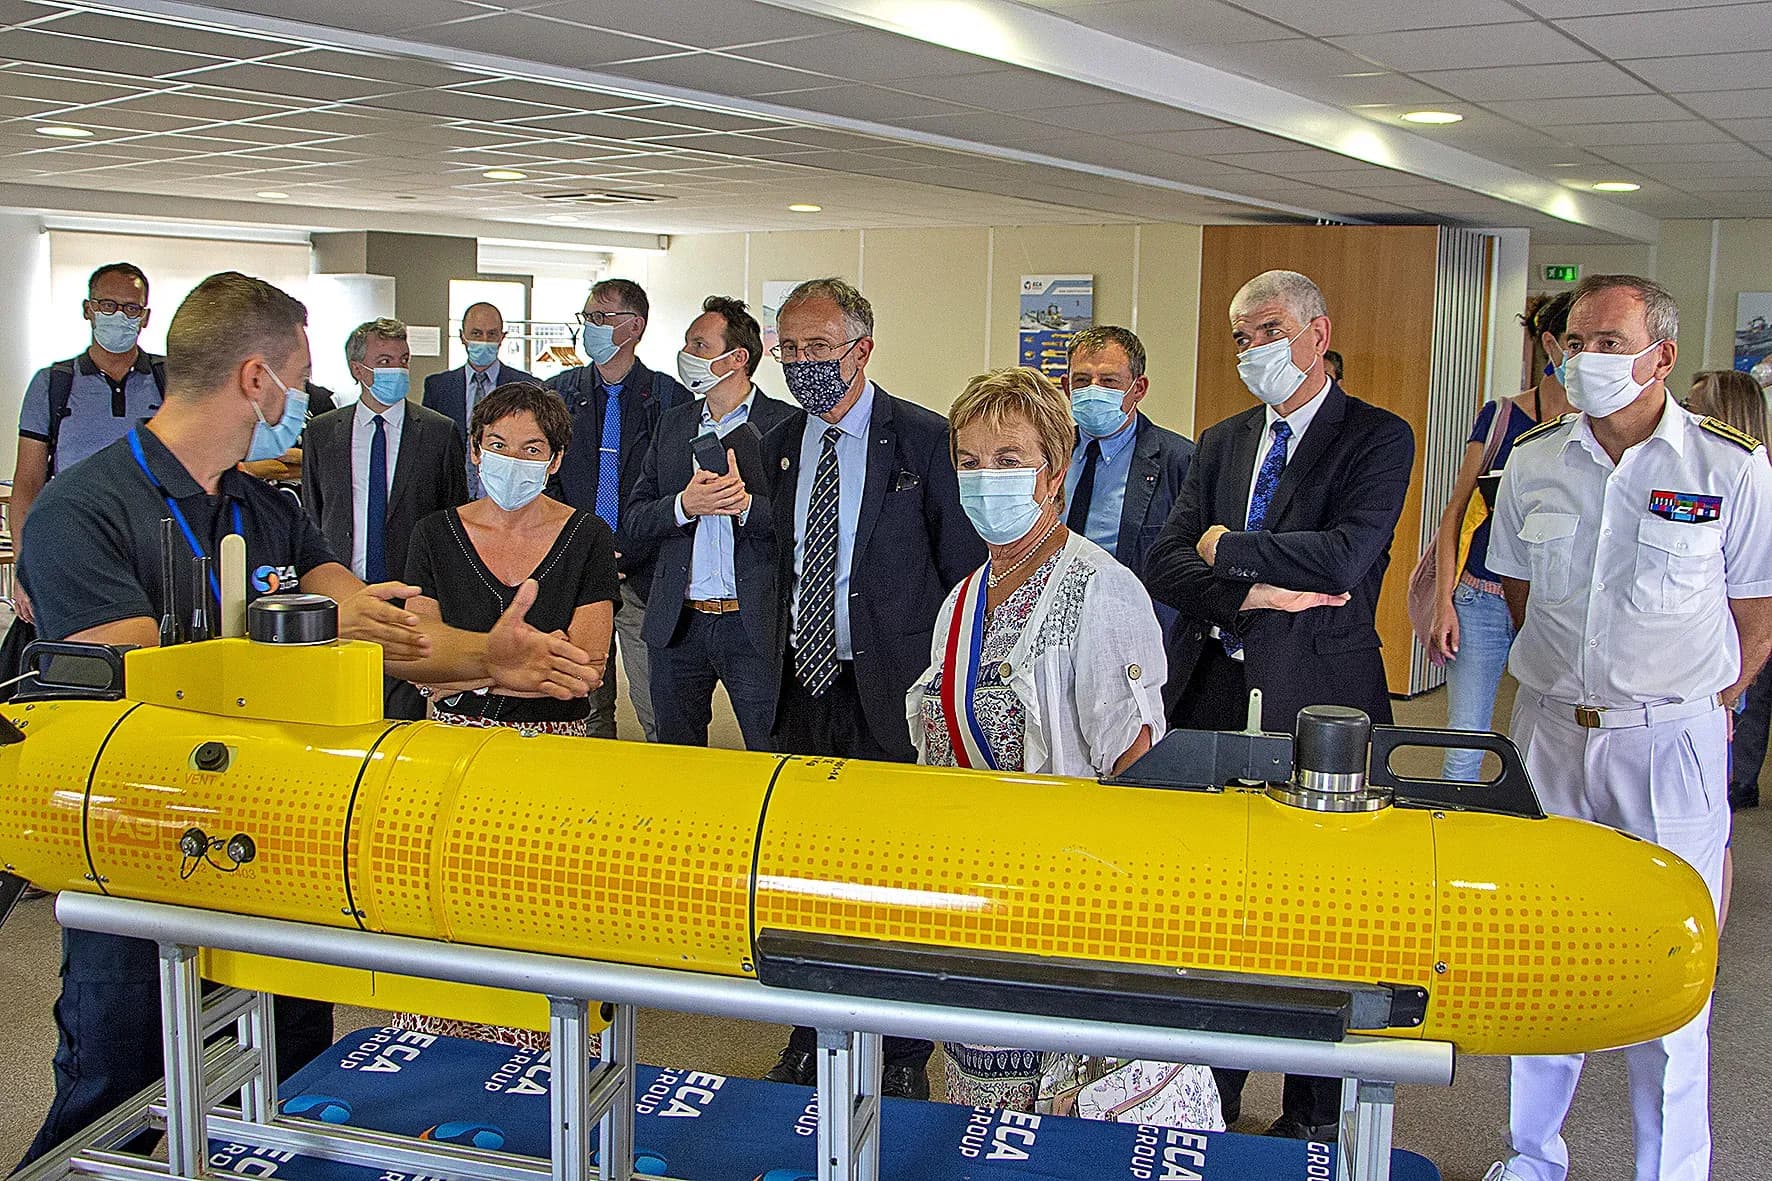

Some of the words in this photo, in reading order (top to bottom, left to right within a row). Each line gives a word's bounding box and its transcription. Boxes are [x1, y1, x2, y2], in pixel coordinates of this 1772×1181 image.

[184, 772, 217, 785] VENT
[339, 1026, 401, 1069] GROUP
[359, 1030, 439, 1073] ECA
[657, 1070, 728, 1118] ECA
[958, 1105, 996, 1158] GROUP
[984, 1109, 1042, 1160] ECA
[1129, 1124, 1160, 1180] GROUP
[1158, 1128, 1208, 1181] ECA
